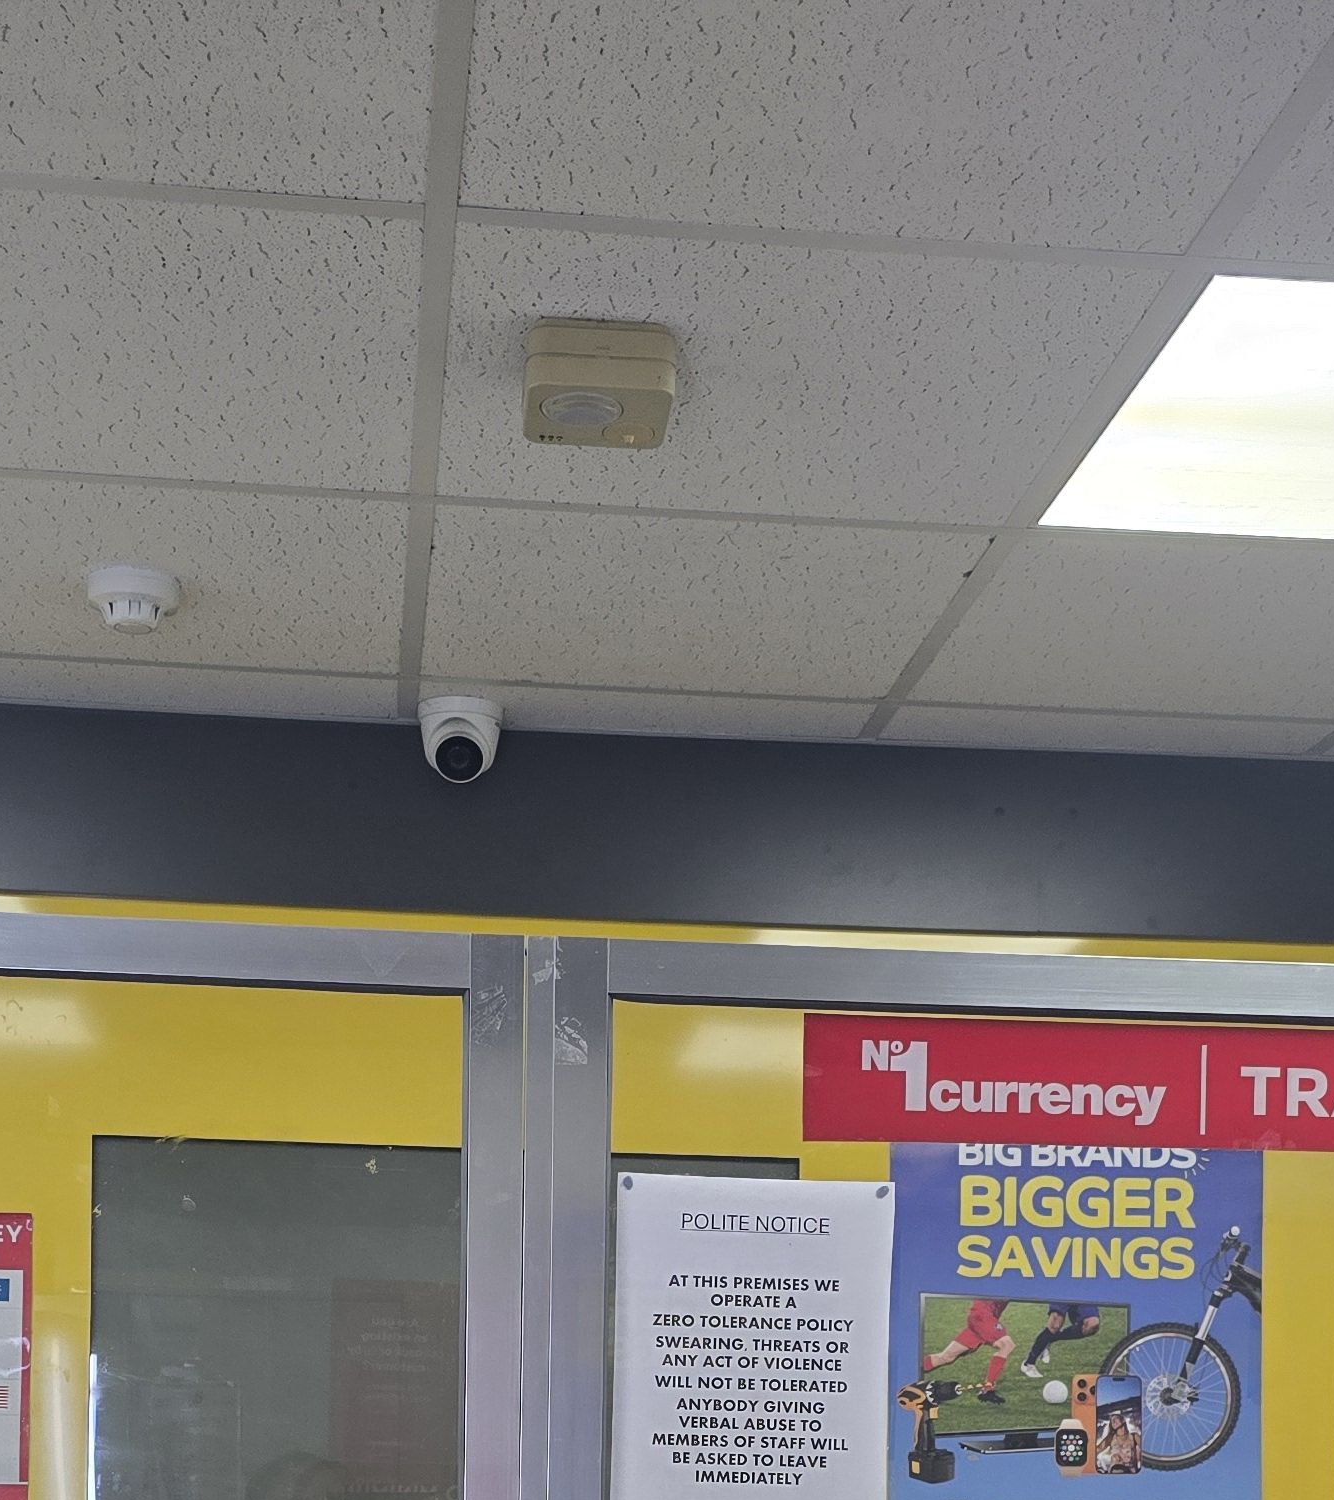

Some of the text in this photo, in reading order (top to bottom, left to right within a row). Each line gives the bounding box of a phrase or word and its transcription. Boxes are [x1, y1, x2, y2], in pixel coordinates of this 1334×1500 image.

[959, 1174, 1195, 1228] BIGGER
[680, 1213, 831, 1234] POLITE NOTICE
[957, 1235, 1195, 1280] SAVINGS
[653, 1314, 853, 1332] ZERO TOLERANCE POLICY
[656, 1336, 849, 1353] SWEARING, THREATS OR
[655, 1375, 848, 1393] WILL NOT BE TOLERATED
[677, 1398, 825, 1414] ANYBODY GIVING
[652, 1433, 848, 1451] MEMBERS OF STAFF WILL
[695, 1470, 802, 1485] IMMEDIATELY
